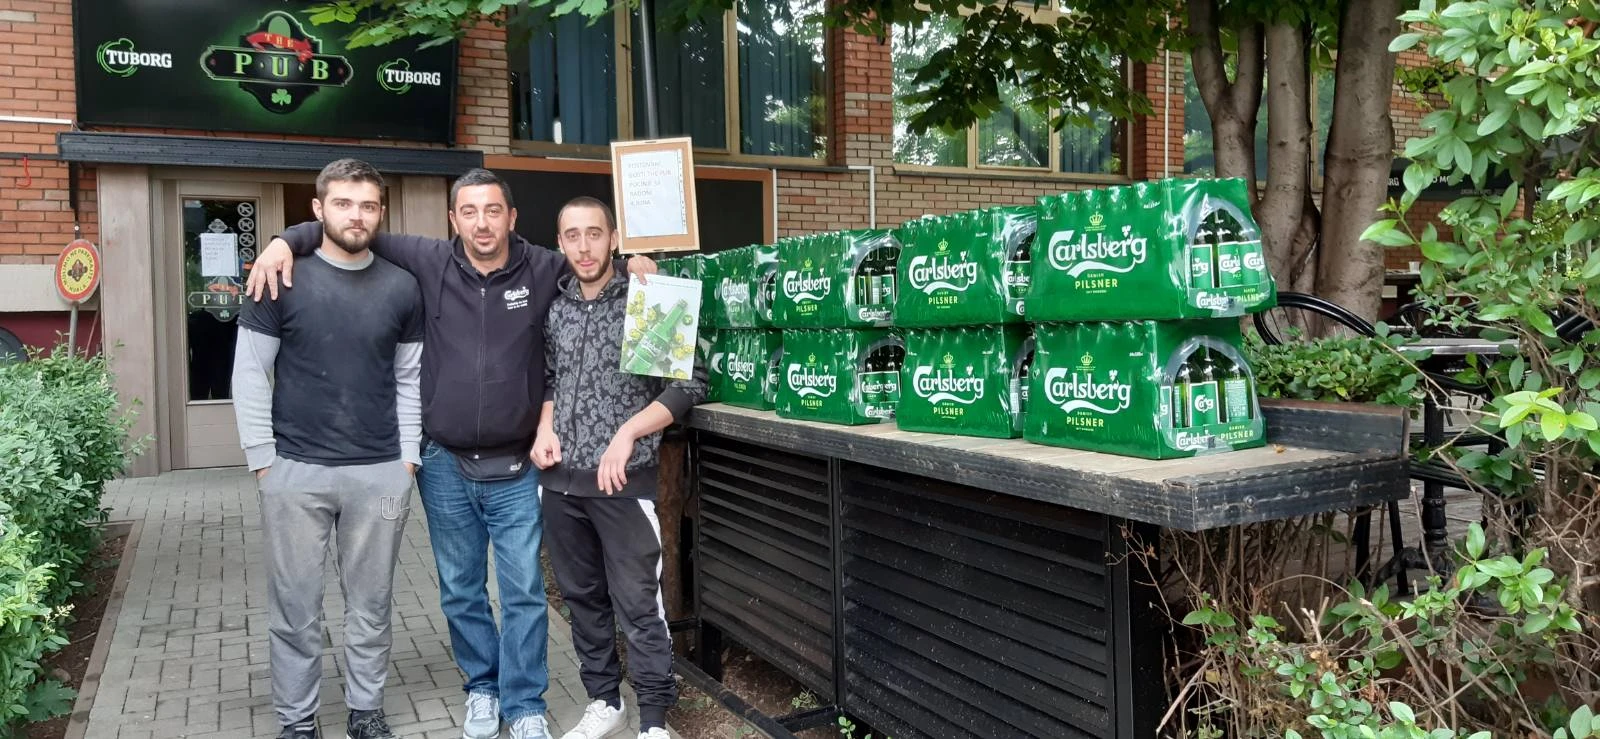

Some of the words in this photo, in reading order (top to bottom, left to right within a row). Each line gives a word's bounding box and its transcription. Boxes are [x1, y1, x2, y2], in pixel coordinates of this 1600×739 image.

[264, 33, 294, 48] THE
[106, 50, 172, 68] TUBORG
[385, 69, 441, 86] TUBORG
[1048, 225, 1147, 278] Carlsberg
[909, 251, 977, 295] Carlsberg
[783, 268, 831, 304] Carlsberg
[1075, 278, 1118, 289] PILSNER
[796, 304, 818, 313] PILSNER
[928, 295, 958, 305] PILSNER
[727, 352, 755, 382] Carlsberg
[787, 363, 837, 398] Carlsberg
[913, 364, 984, 405] Carlsberg
[1044, 370, 1131, 413] Carlsberg
[801, 399, 822, 407] PILSNER
[933, 406, 964, 416] PILSNER
[1066, 416, 1104, 427] PILSNER
[1220, 429, 1254, 440] PILSNER
